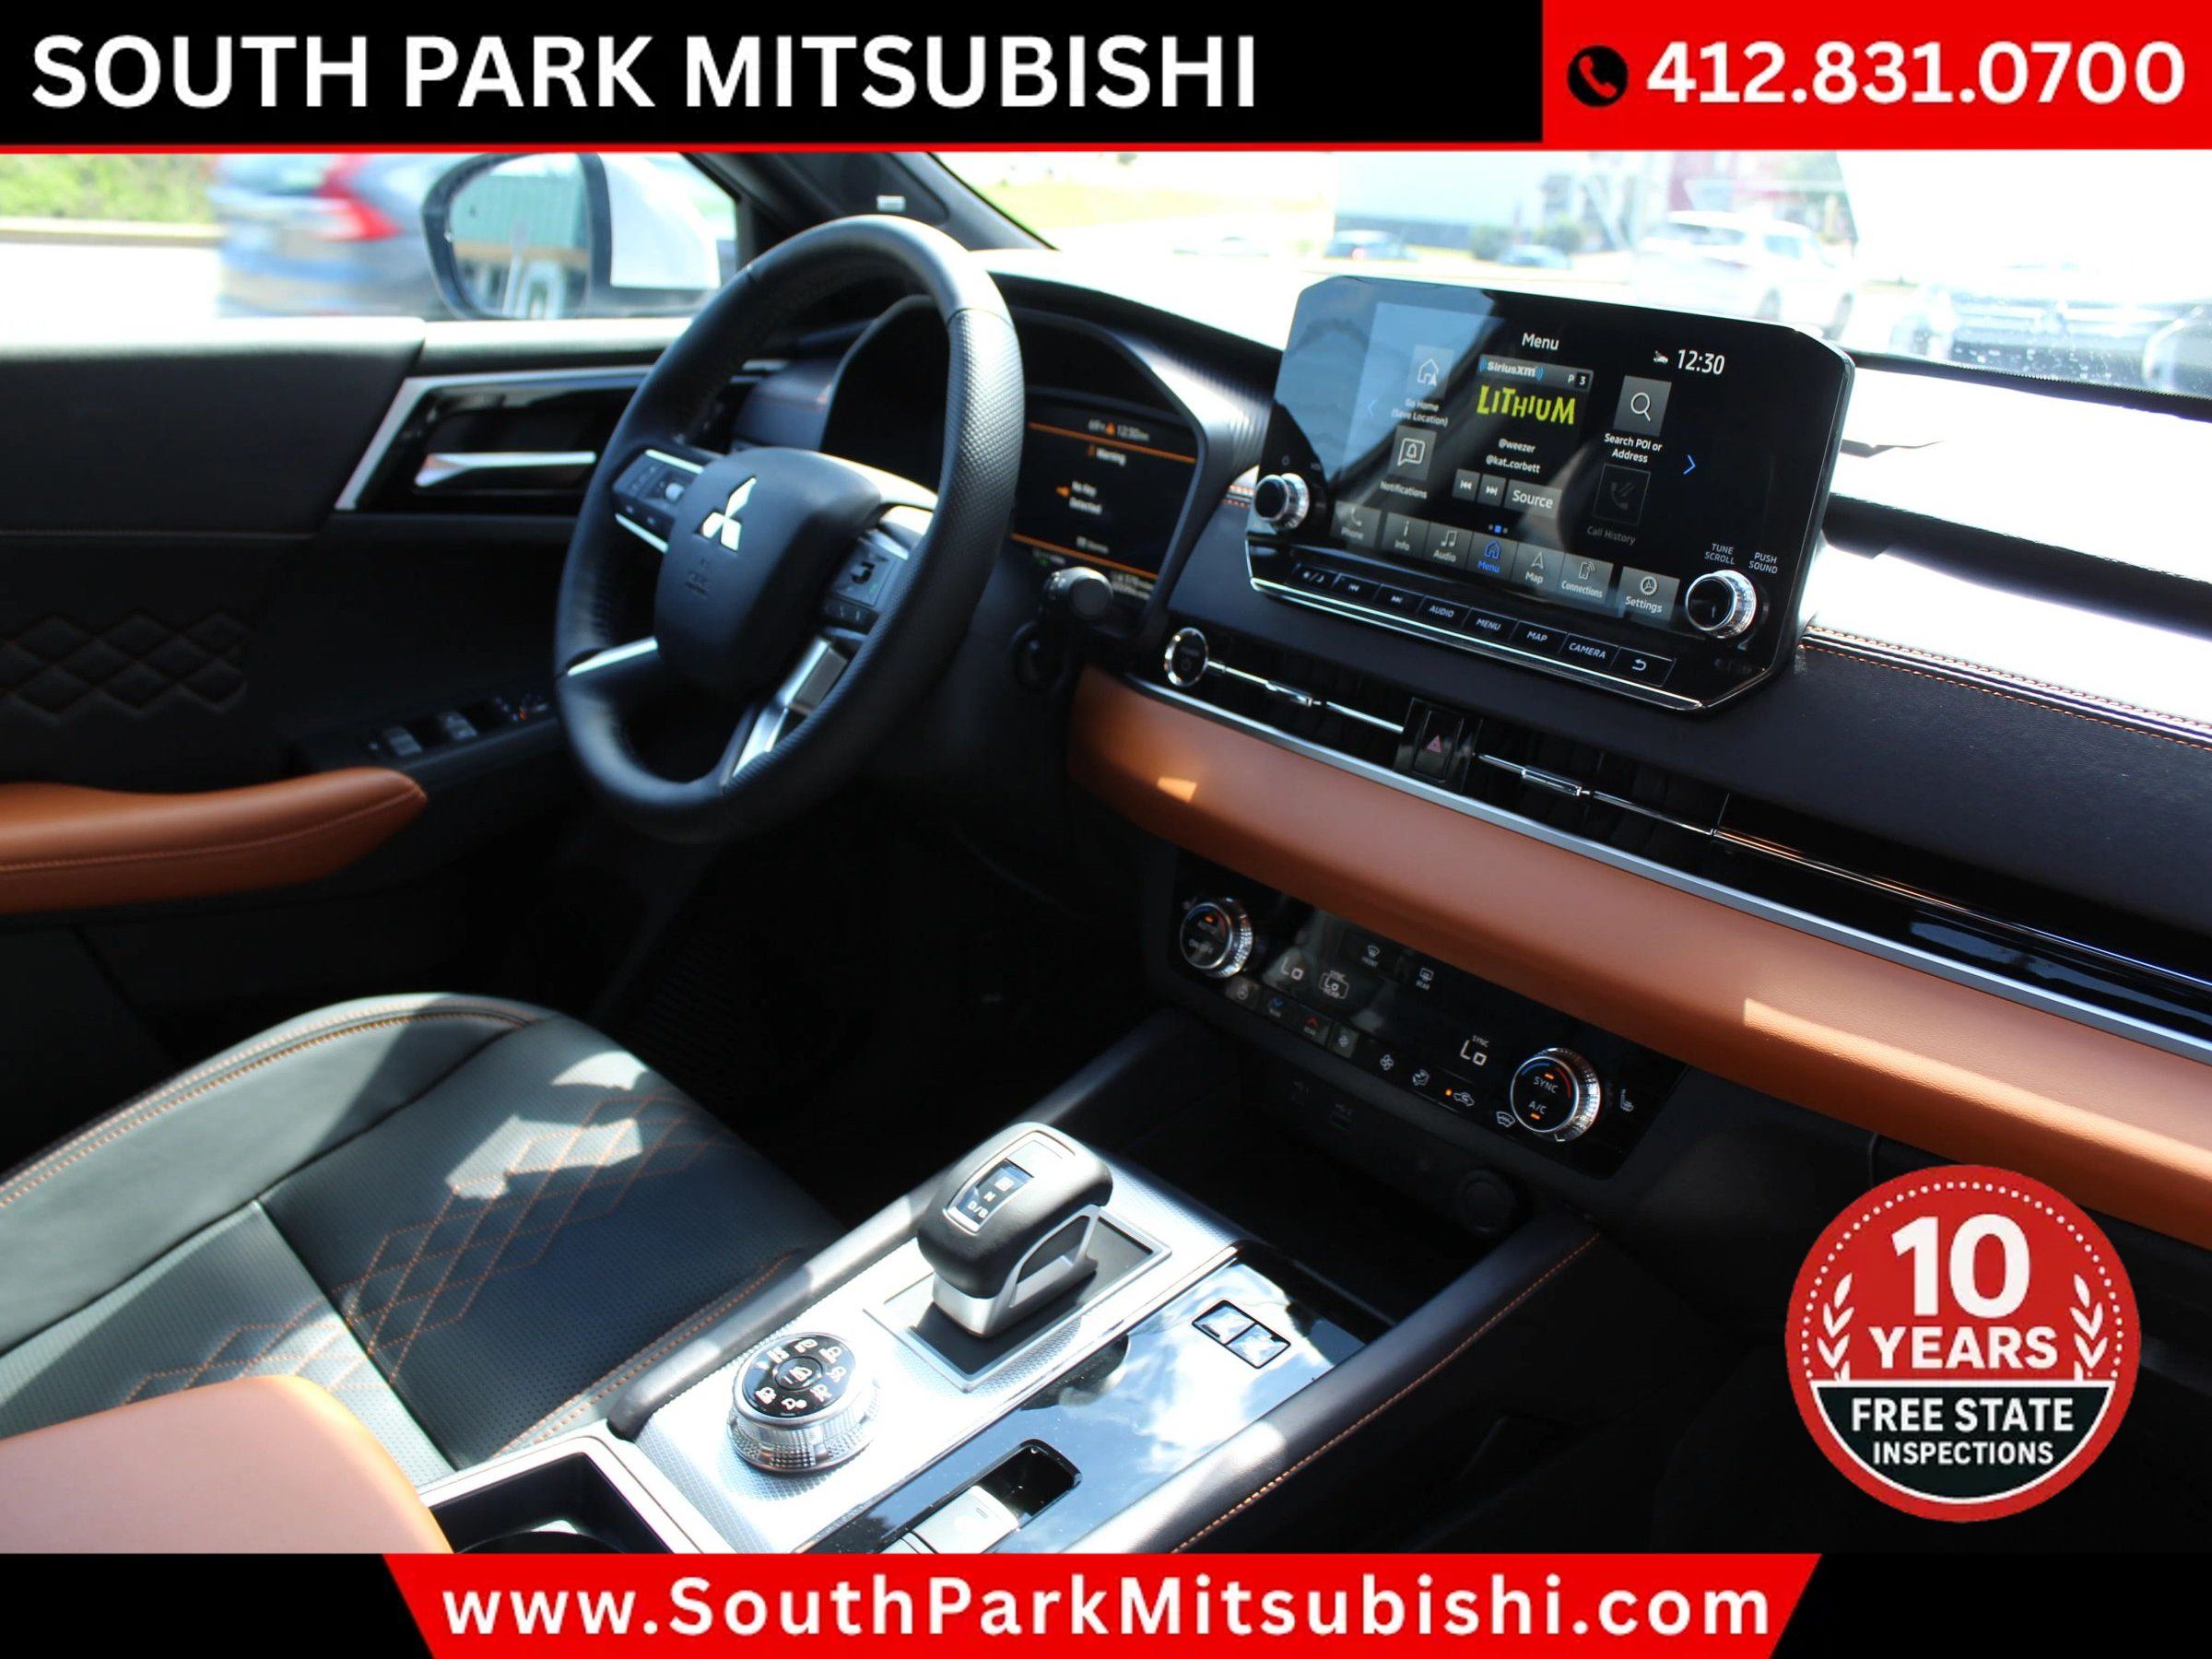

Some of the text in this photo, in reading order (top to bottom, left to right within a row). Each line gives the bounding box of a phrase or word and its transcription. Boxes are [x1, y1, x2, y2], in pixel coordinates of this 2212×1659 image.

[1522, 333, 1559, 350] Menu
[1677, 349, 1725, 375] 12:30
[1417, 400, 1440, 413] Home
[1413, 412, 1449, 428] Location)
[1498, 438, 1535, 453] @weezer
[1604, 432, 1663, 452] Search POI or
[1611, 448, 1649, 464] Address
[1379, 480, 1429, 500] Notifications
[1512, 489, 1554, 509] Source
[1587, 525, 1637, 546] Call History
[1394, 539, 1410, 551] Info
[1712, 543, 1734, 555] TUNE
[1433, 549, 1457, 563] Audio
[1704, 552, 1735, 565] SCROLL
[1754, 552, 1778, 564] PUSH
[1477, 559, 1500, 574] Menu
[1748, 560, 1778, 574] SOUND
[1525, 571, 1544, 585] Map
[1561, 580, 1603, 599] Connections
[1430, 605, 1454, 618] AUDIO
[1625, 595, 1663, 614] Settings
[1476, 618, 1501, 631] MENU
[1526, 630, 1547, 642] MAP
[1569, 642, 1607, 660] CAMERA
[1533, 1076, 1559, 1094] SYNC
[1528, 1100, 1547, 1115] A/C
